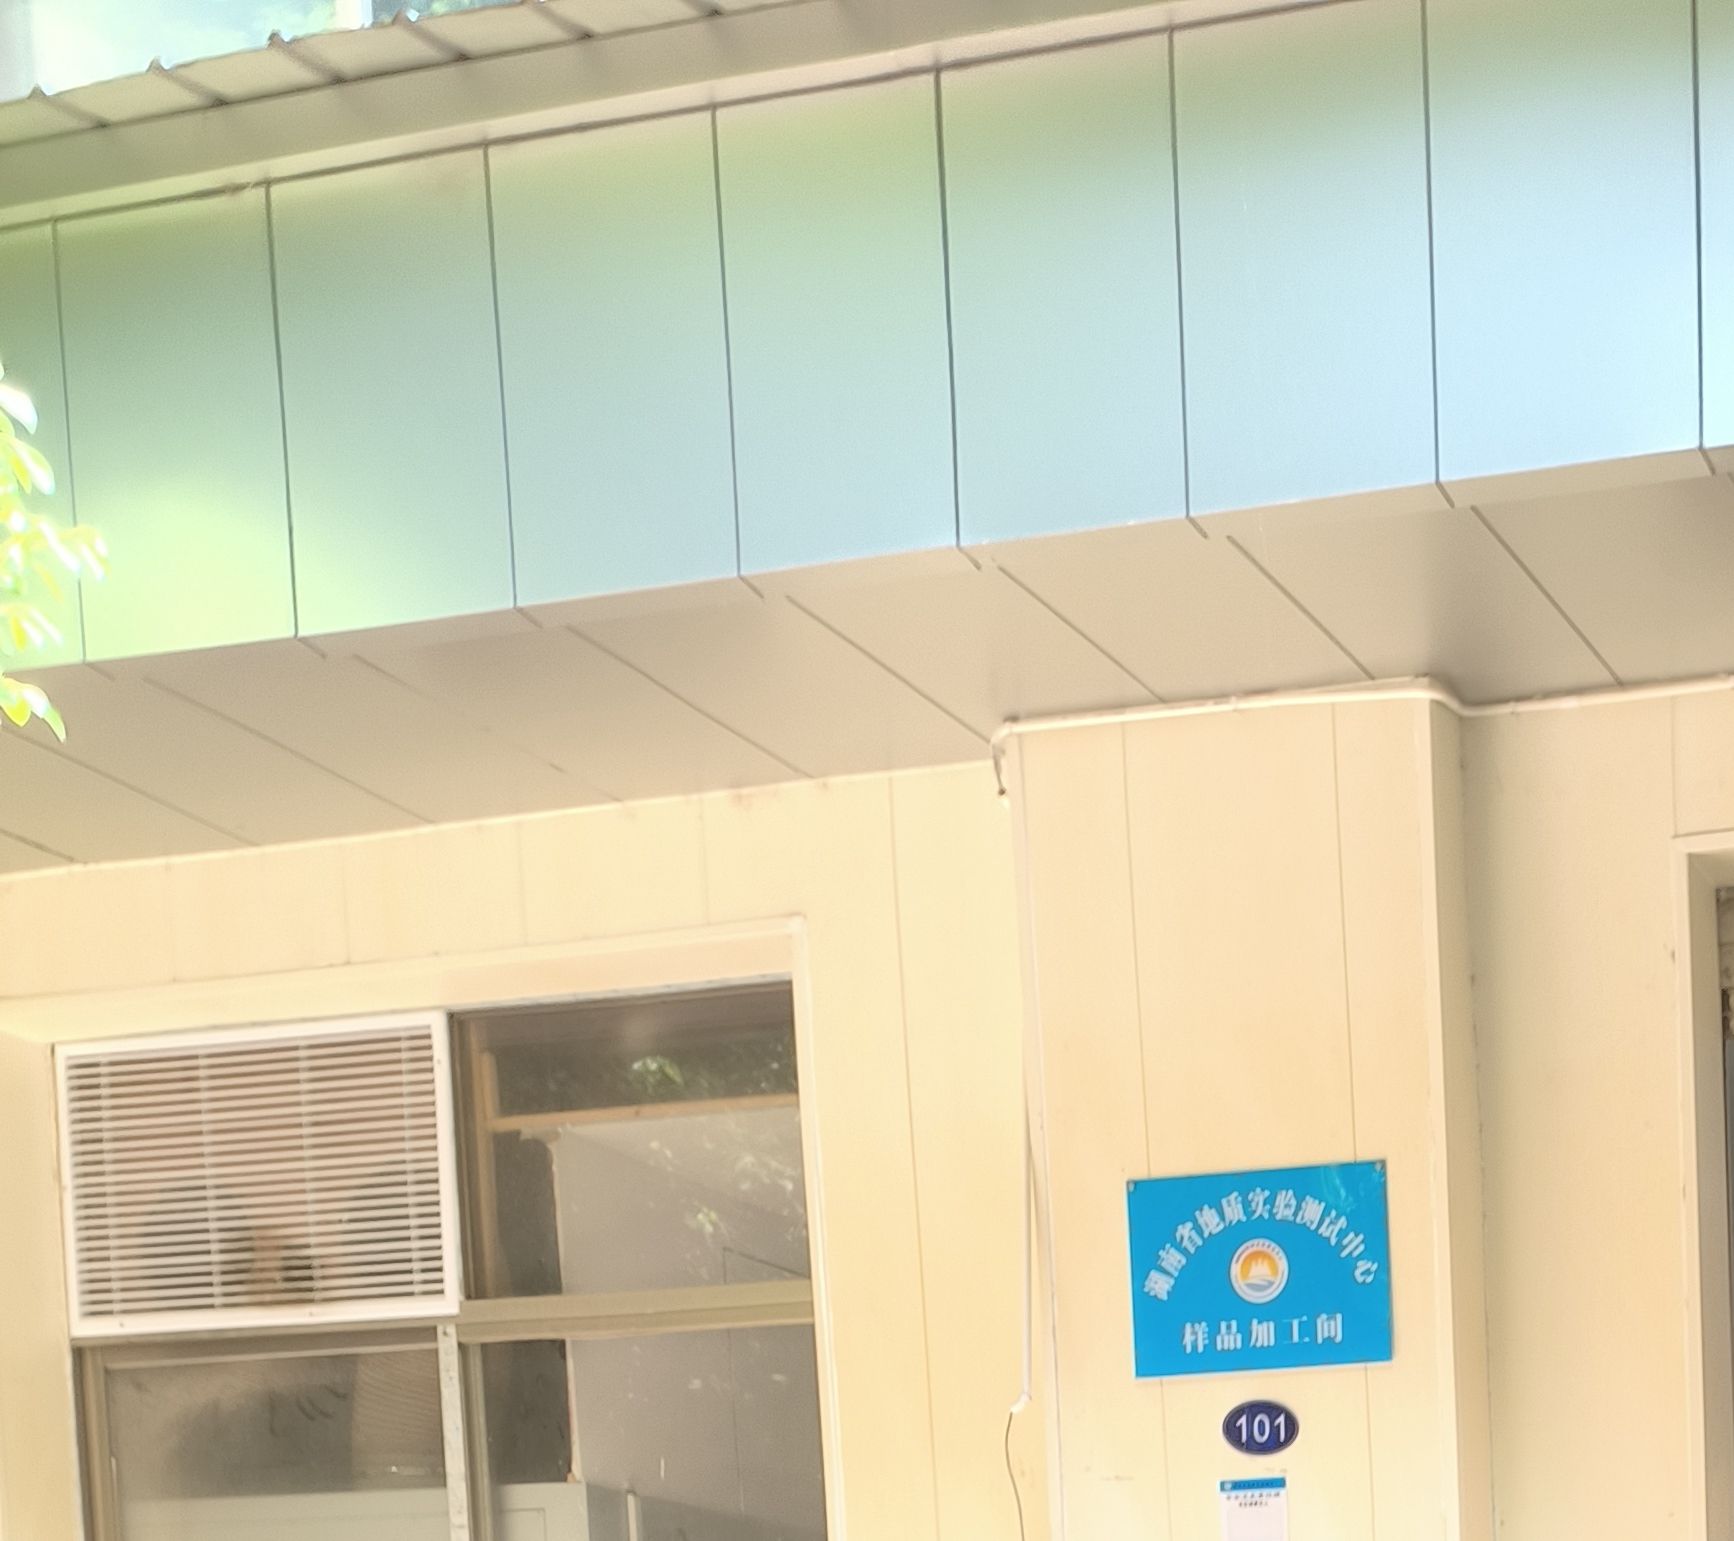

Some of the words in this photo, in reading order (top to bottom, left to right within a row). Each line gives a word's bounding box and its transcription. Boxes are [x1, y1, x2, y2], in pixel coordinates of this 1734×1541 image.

[1143, 1187, 1378, 1301] 湖南省地质实验测试中心
[1182, 1313, 1343, 1354] 样品加工间
[1235, 1412, 1287, 1443] 101
